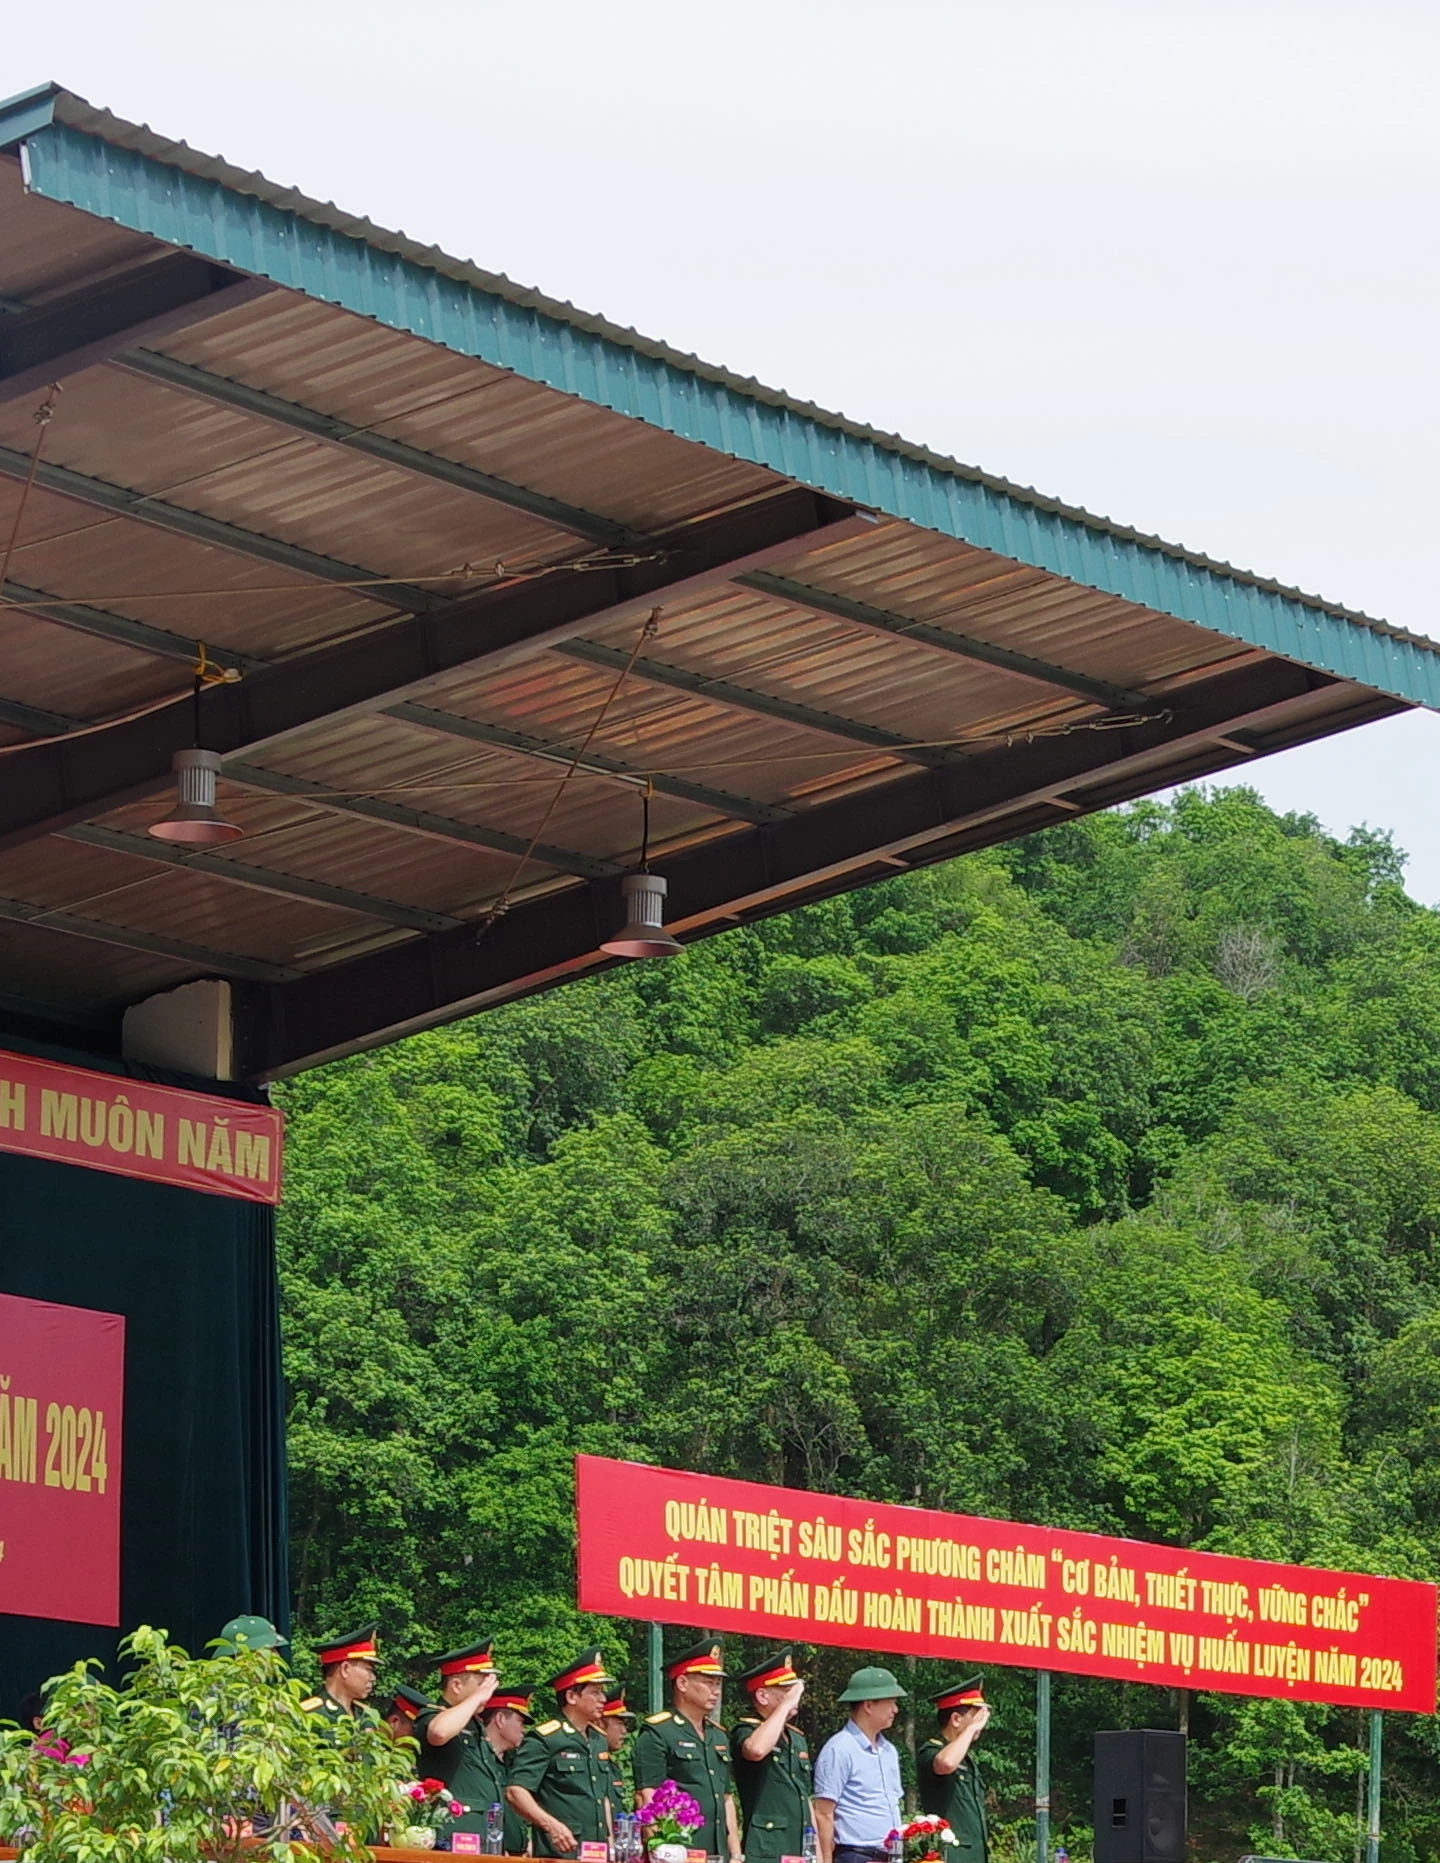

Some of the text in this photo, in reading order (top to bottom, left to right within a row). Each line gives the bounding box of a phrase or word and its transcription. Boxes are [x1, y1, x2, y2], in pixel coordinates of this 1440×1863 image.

[40, 1088, 165, 1160] MUÔN
[177, 1118, 271, 1182] NĂM
[44, 1402, 108, 1493] 2024
[665, 1498, 728, 1545] QUÁN
[731, 1509, 793, 1560] TRIỆT
[798, 1516, 843, 1562] SÂU
[847, 1518, 892, 1569] SẮC
[895, 1535, 981, 1581] PHƯƠNG
[985, 1545, 1046, 1589] CHÂM
[1093, 1555, 1141, 1607] BẢN,
[1145, 1568, 1198, 1611] THIẾT
[1199, 1580, 1255, 1624] THỰC,
[1258, 1583, 1308, 1626] VỮNG
[619, 1553, 1403, 1691] QUYẾT TÂM PHẤN ĐẤU HOÀN THÀNH XUẤT SẮC NHIỆM VỤ HUẤN LUYỆN NĂM 2024
